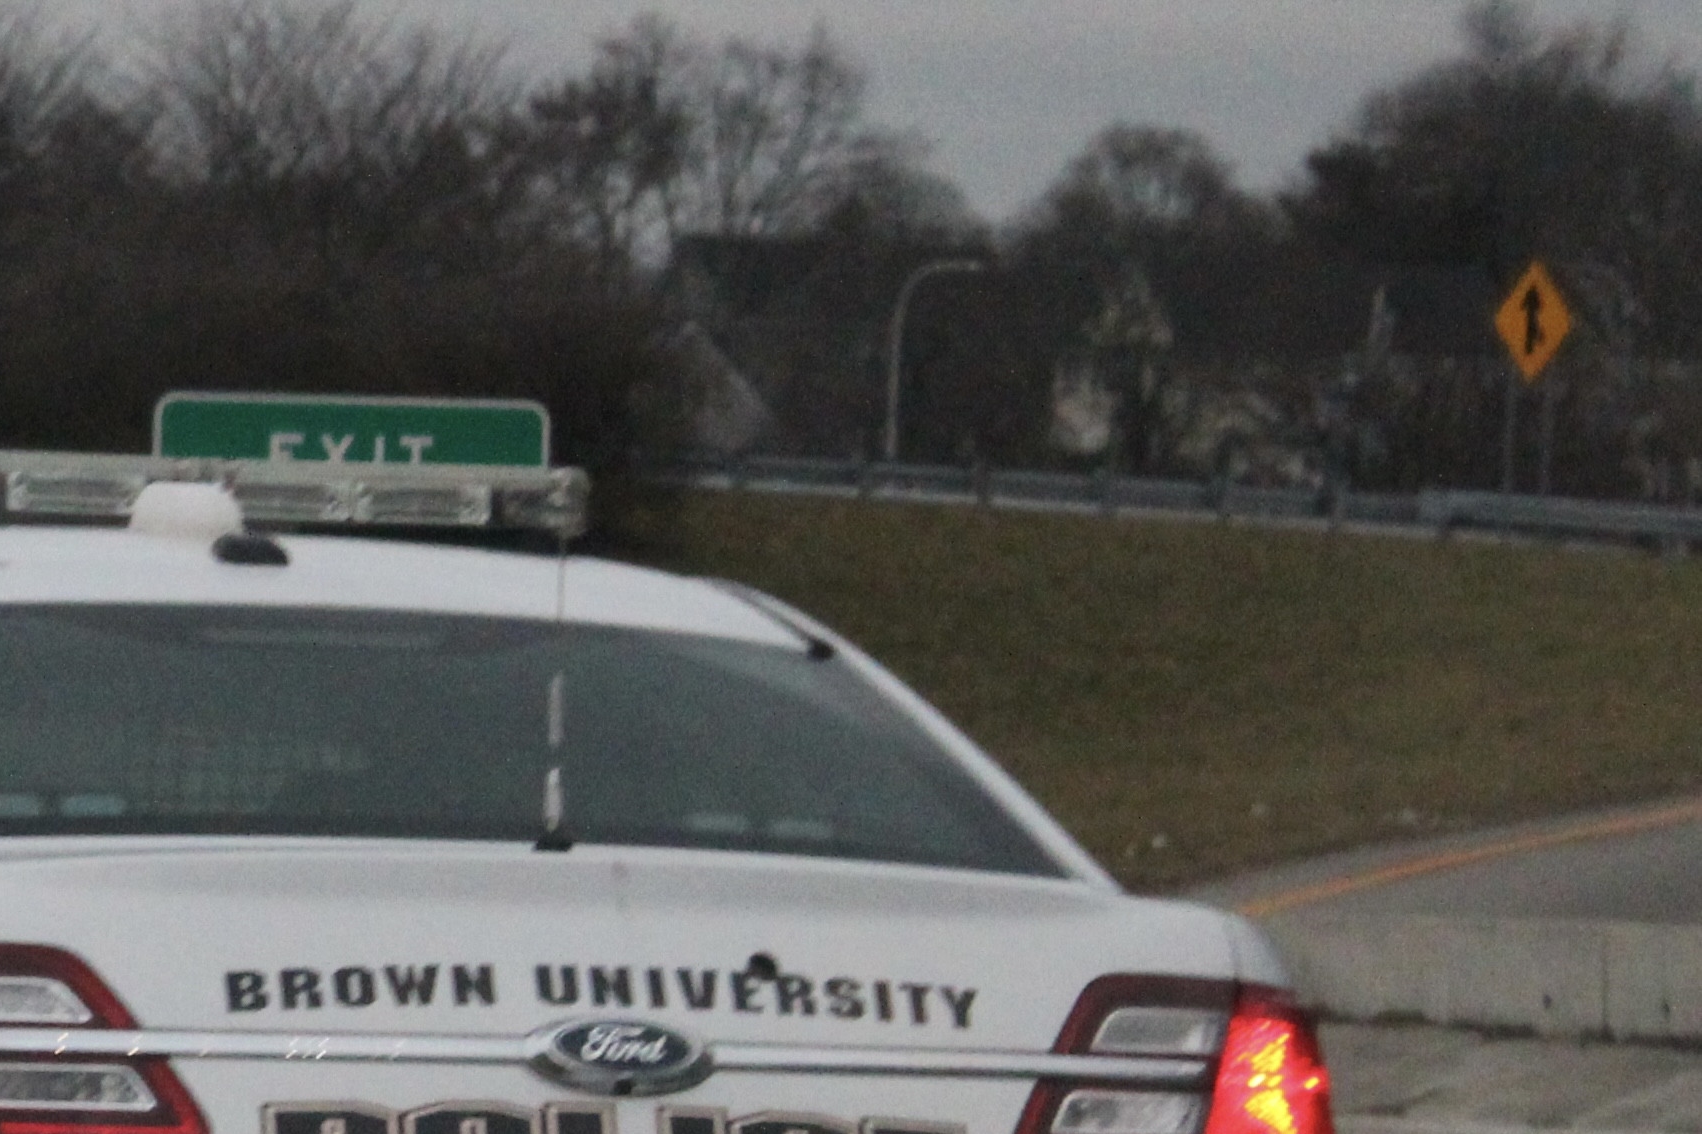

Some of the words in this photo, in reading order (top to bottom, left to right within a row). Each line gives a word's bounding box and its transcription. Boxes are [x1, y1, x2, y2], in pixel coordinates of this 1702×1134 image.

[269, 431, 435, 464] EXIT
[225, 963, 497, 1013] BROWN
[534, 963, 978, 1029] UNIVERSITY
[580, 1026, 668, 1063] Ford
